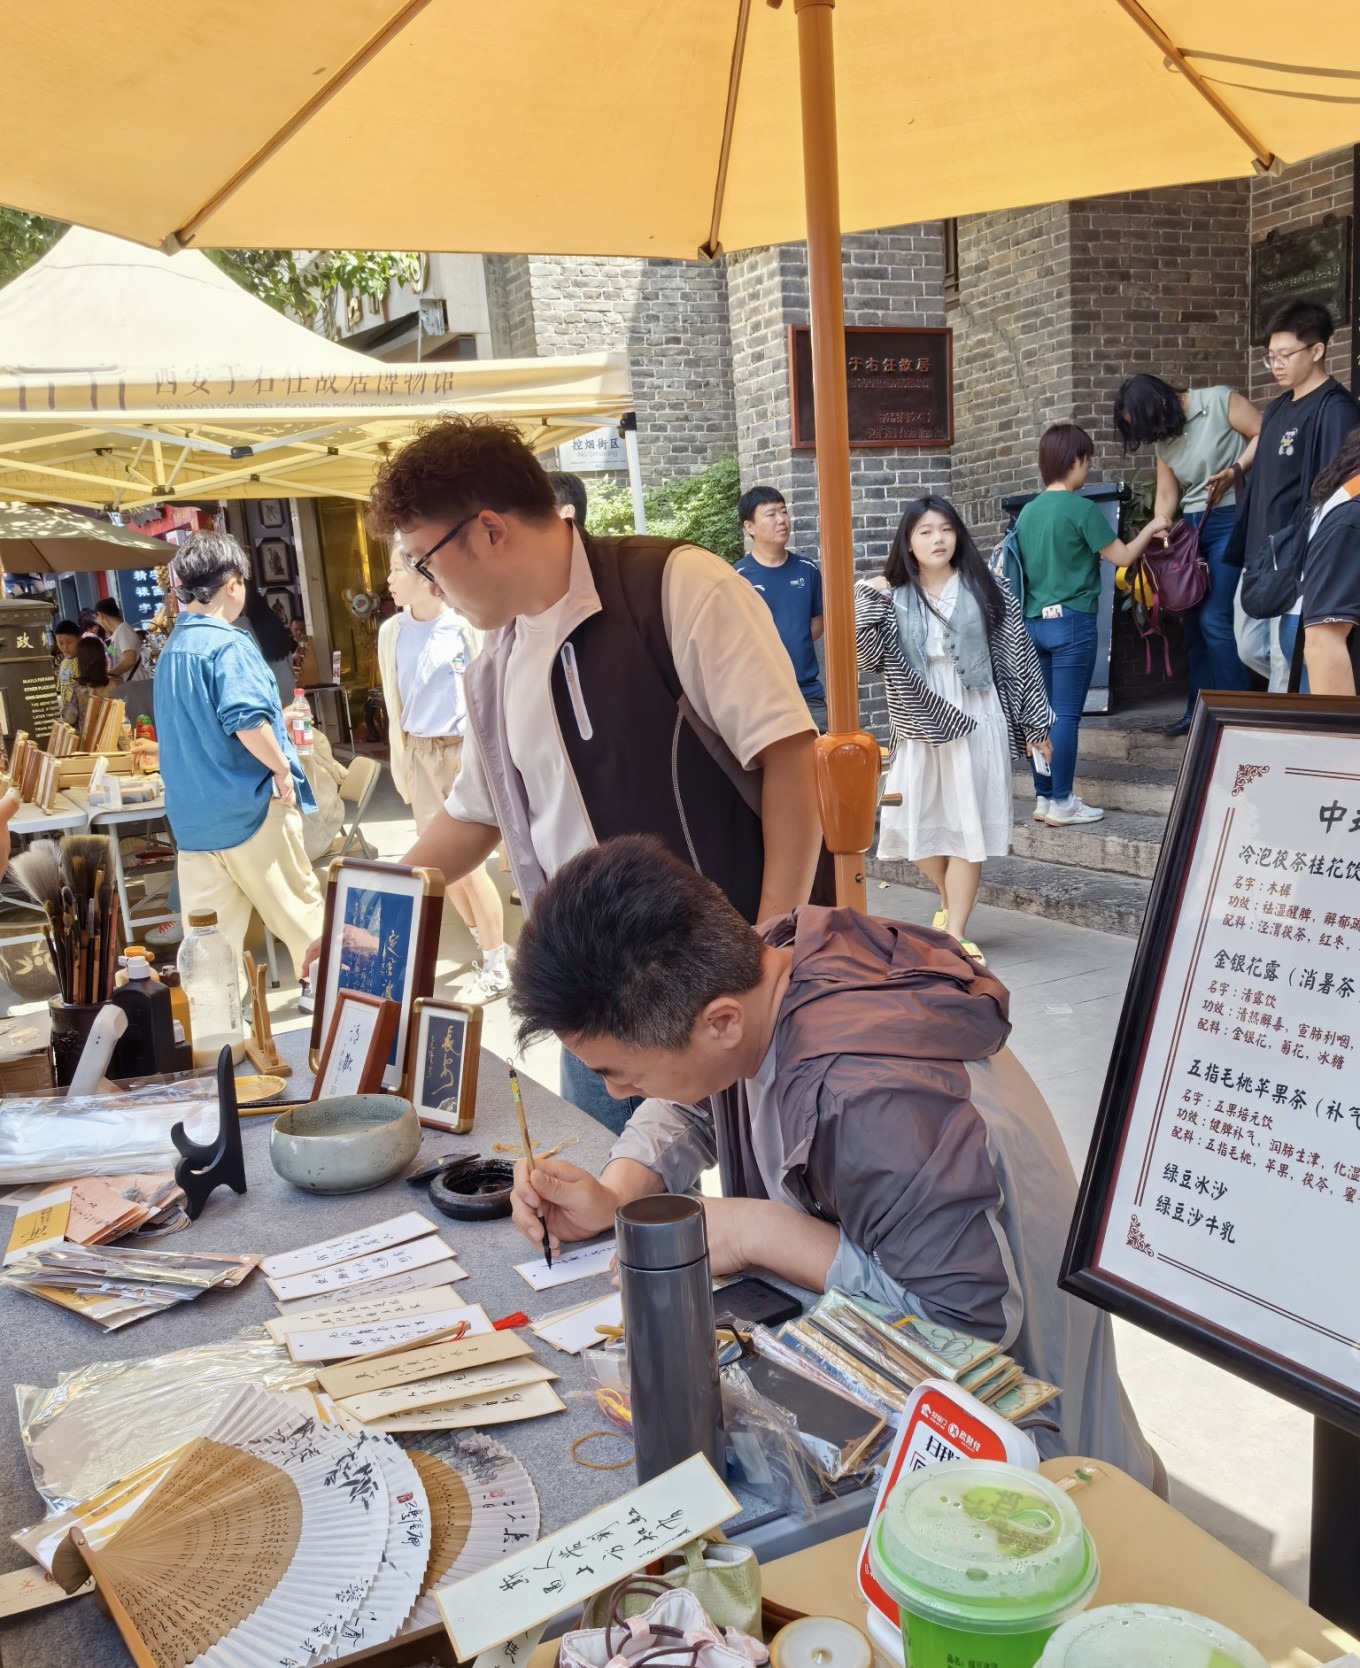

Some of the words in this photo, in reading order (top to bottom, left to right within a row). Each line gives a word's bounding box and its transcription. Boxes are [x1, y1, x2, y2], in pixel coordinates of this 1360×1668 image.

[848, 356, 930, 373] 于右任故居
[572, 437, 620, 450] 控烟街区
[1238, 844, 1360, 882] 冷泡茯茶桂花饮
[1213, 948, 1360, 1002] 金银花露（消暑茶
[1162, 1162, 1229, 1201] 绿豆冰沙
[1171, 1125, 1360, 1203] 配料：五指毛桃，苹果，茯苓，蜜
[1154, 1195, 1236, 1244] 绿豆沙牛乳
